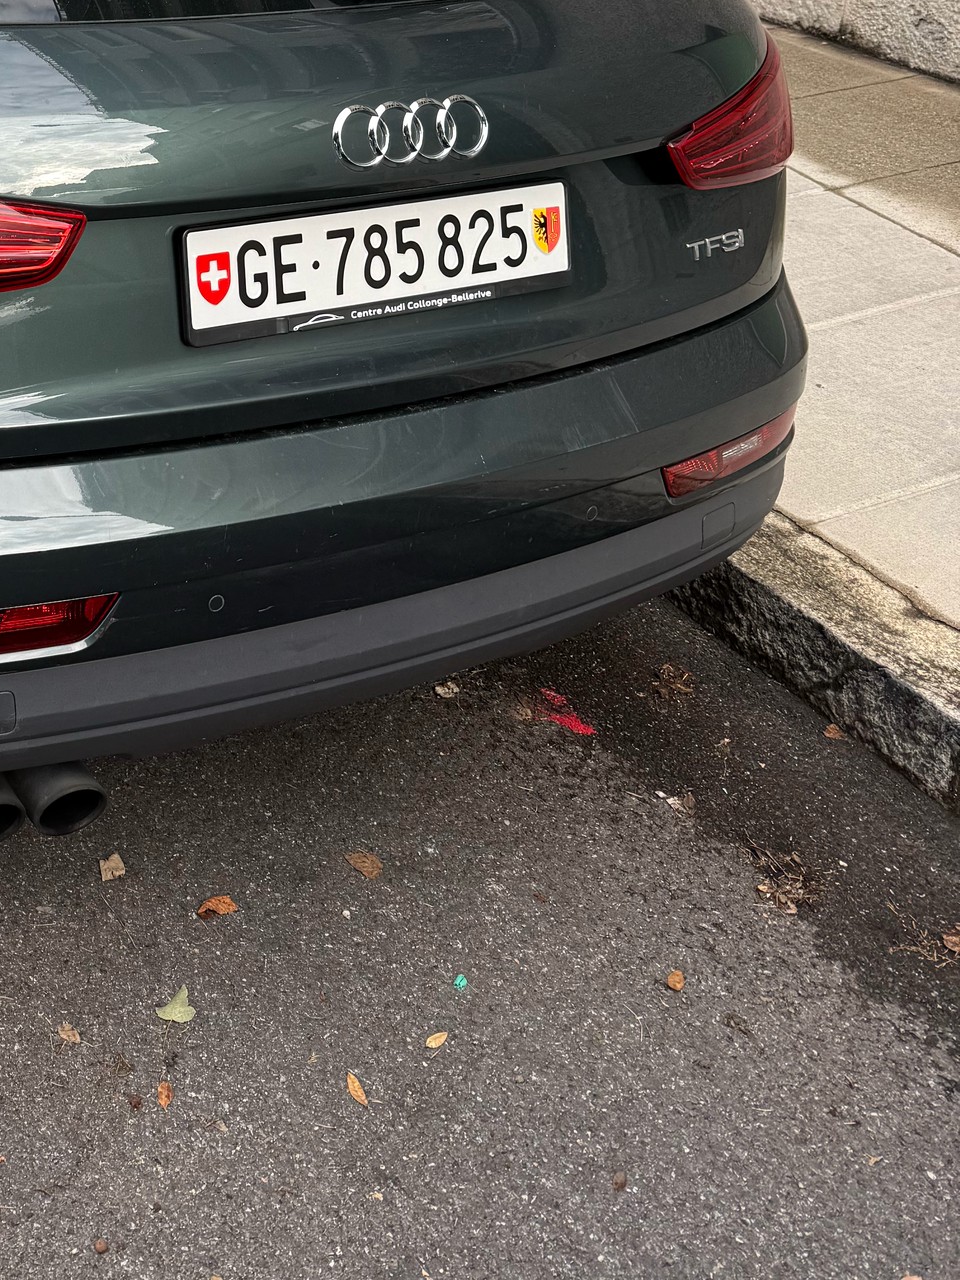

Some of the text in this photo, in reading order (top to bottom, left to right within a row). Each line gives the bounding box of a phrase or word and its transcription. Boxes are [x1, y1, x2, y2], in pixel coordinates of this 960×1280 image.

[685, 228, 745, 261] TFSI
[350, 289, 492, 319] Centre Audi Collonge-Bellerive
